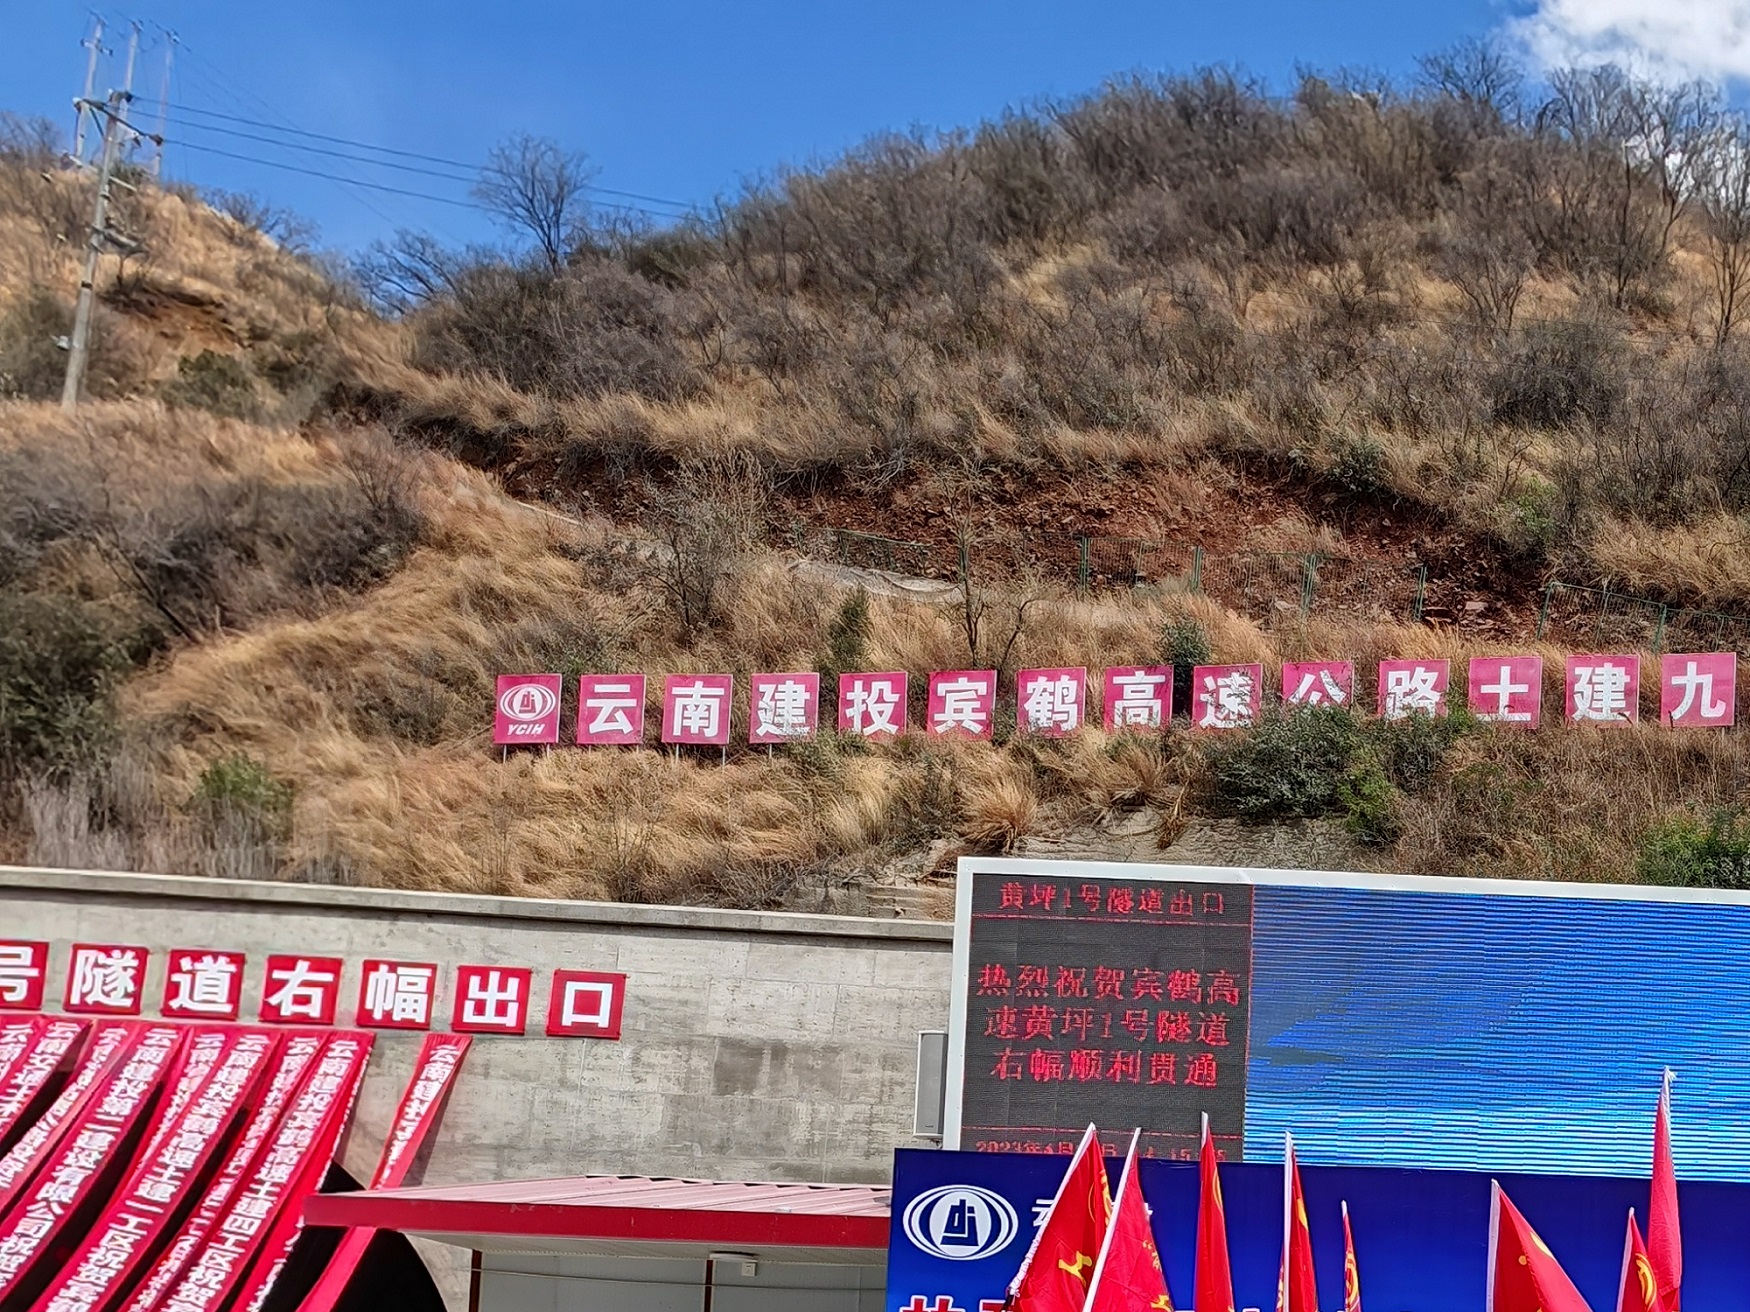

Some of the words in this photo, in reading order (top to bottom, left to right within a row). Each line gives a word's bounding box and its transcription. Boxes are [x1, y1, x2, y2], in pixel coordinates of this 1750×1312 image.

[507, 723, 545, 735] YCIH
[1000, 883, 1225, 915] 黄坪1号隧道出口
[0, 945, 612, 1028] 号隧道右幅出口
[976, 963, 1240, 1006] 热烈祝贺宾鹤高
[984, 1004, 1231, 1047] 速黄坪1号隧道
[990, 1048, 1218, 1088] 右幅顺利贯通
